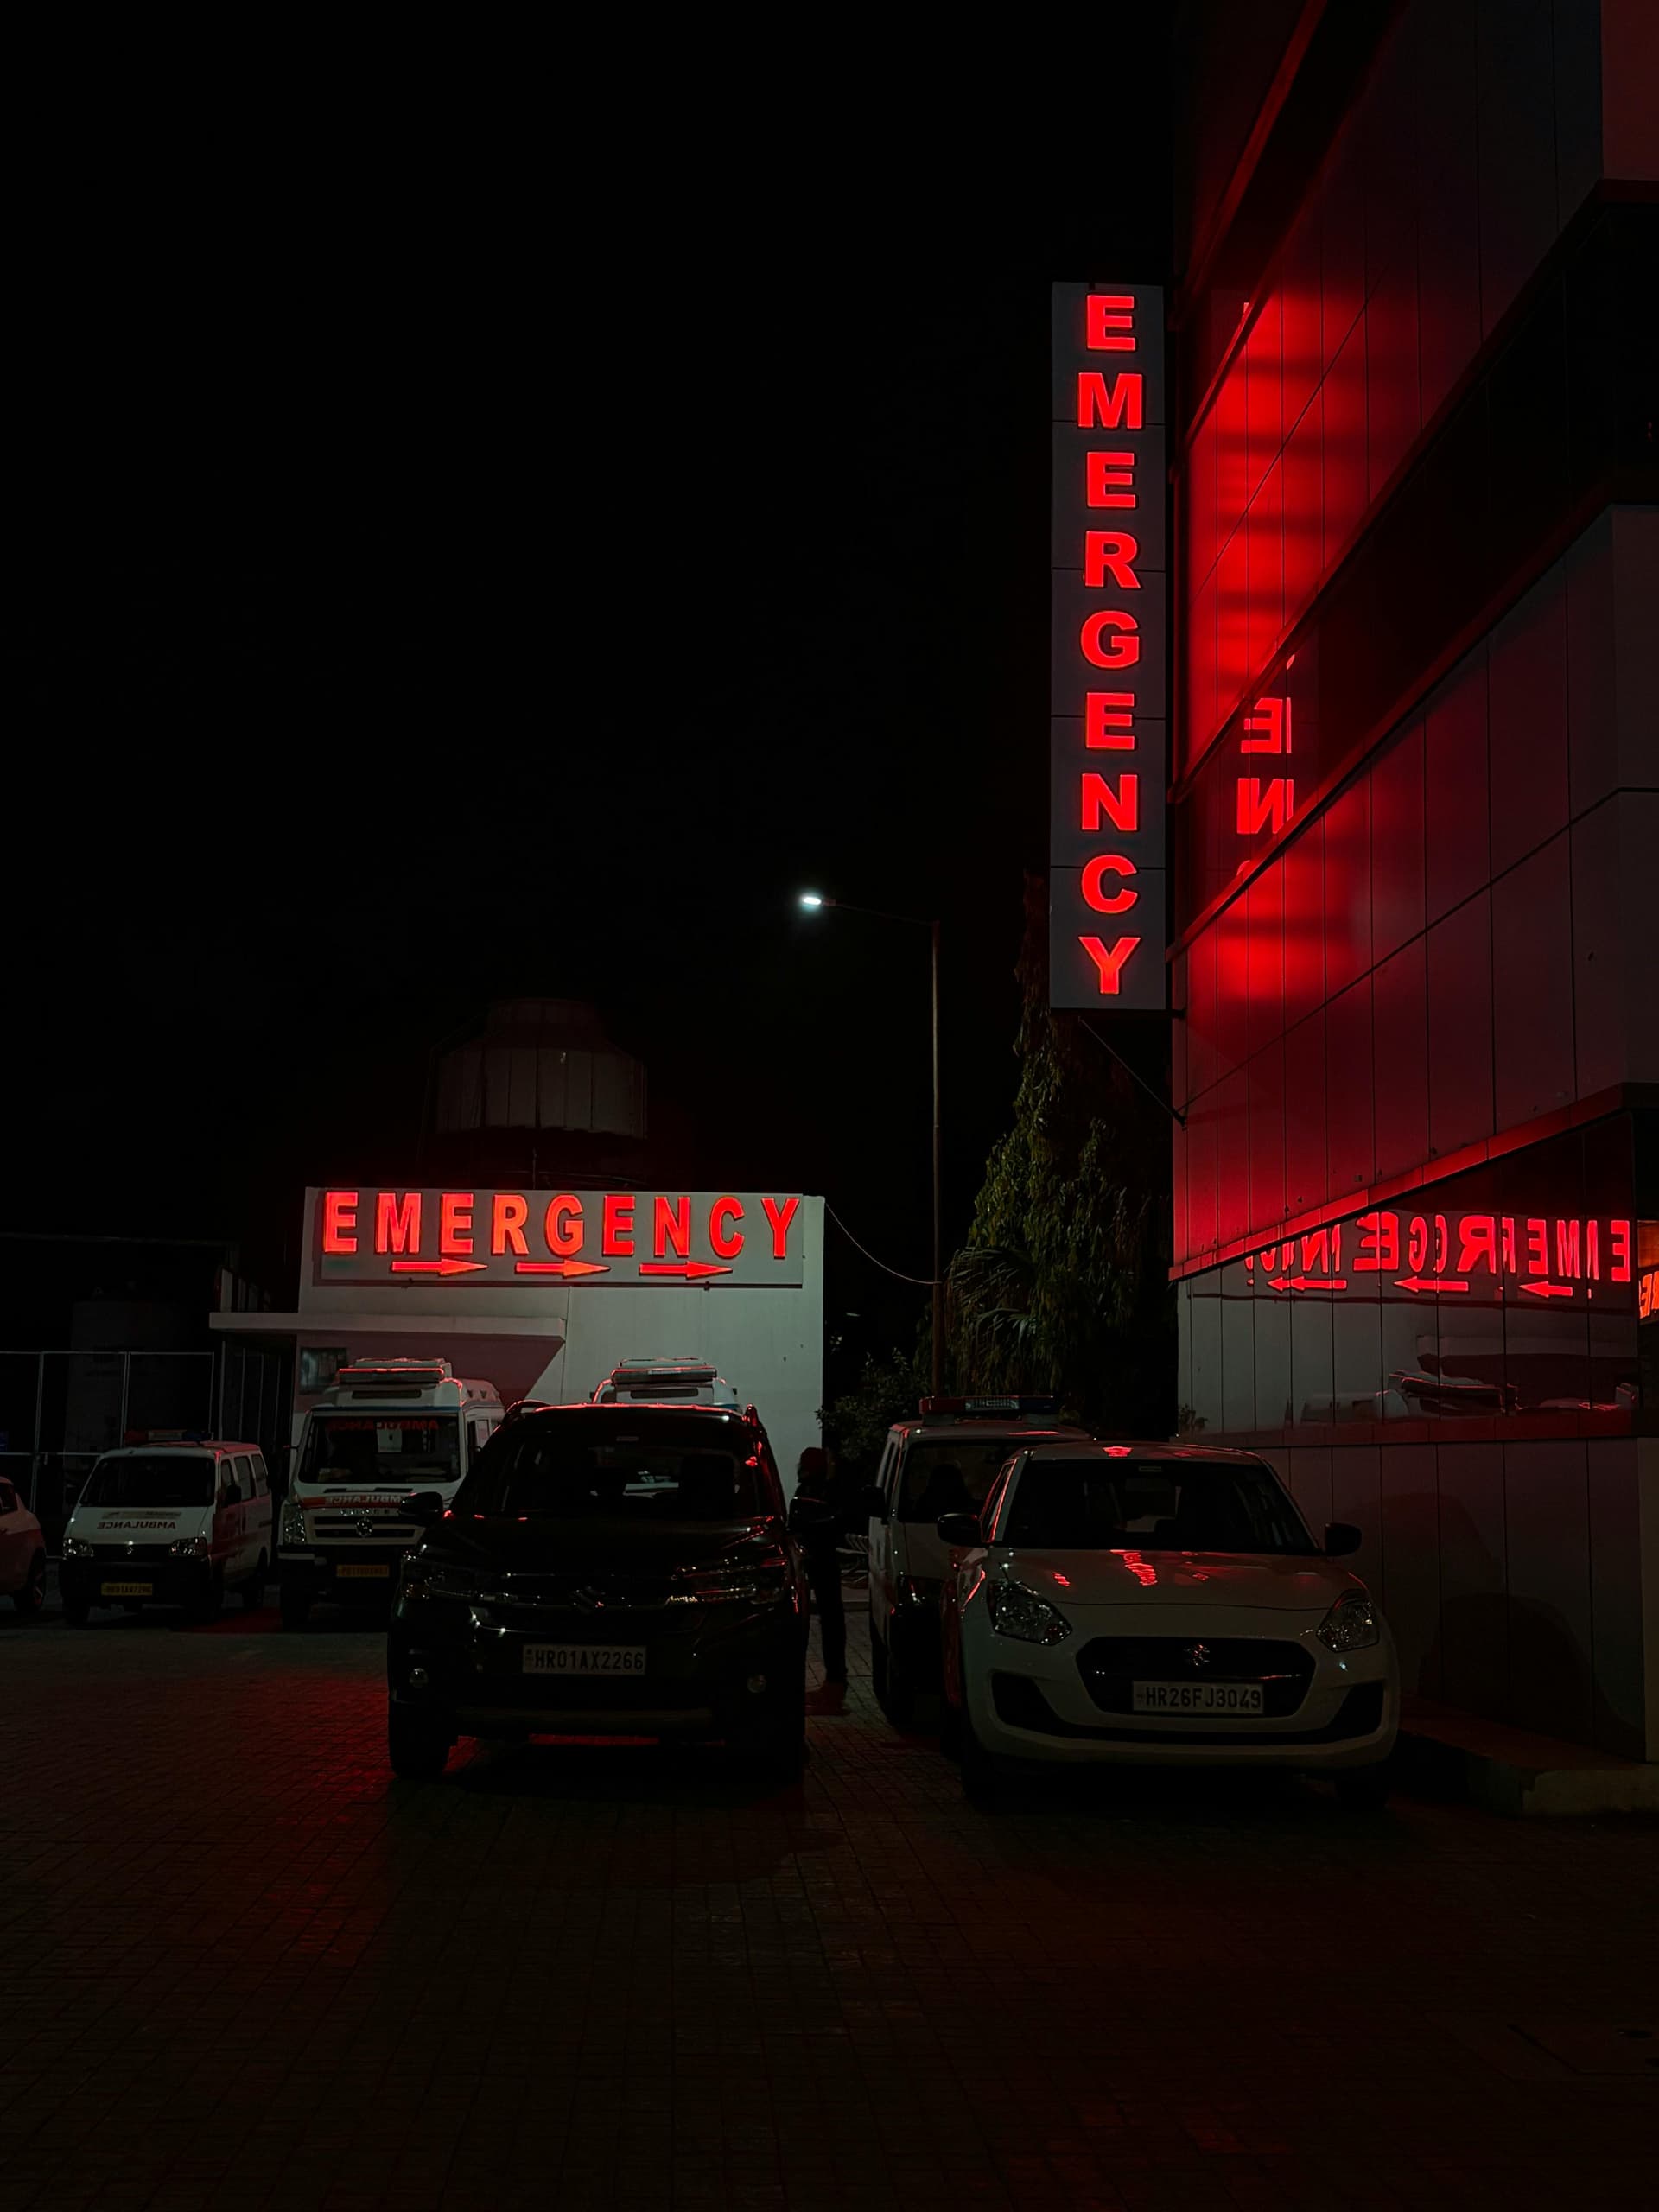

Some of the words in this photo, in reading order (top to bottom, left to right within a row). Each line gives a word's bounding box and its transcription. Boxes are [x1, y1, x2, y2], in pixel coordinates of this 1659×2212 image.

[1077, 294, 1143, 996] EMERGENCY
[323, 1191, 800, 1258] EMERGENCY
[535, 1649, 644, 1669] HR01AX2266
[1146, 1686, 1262, 1709] HR26FJ3049
